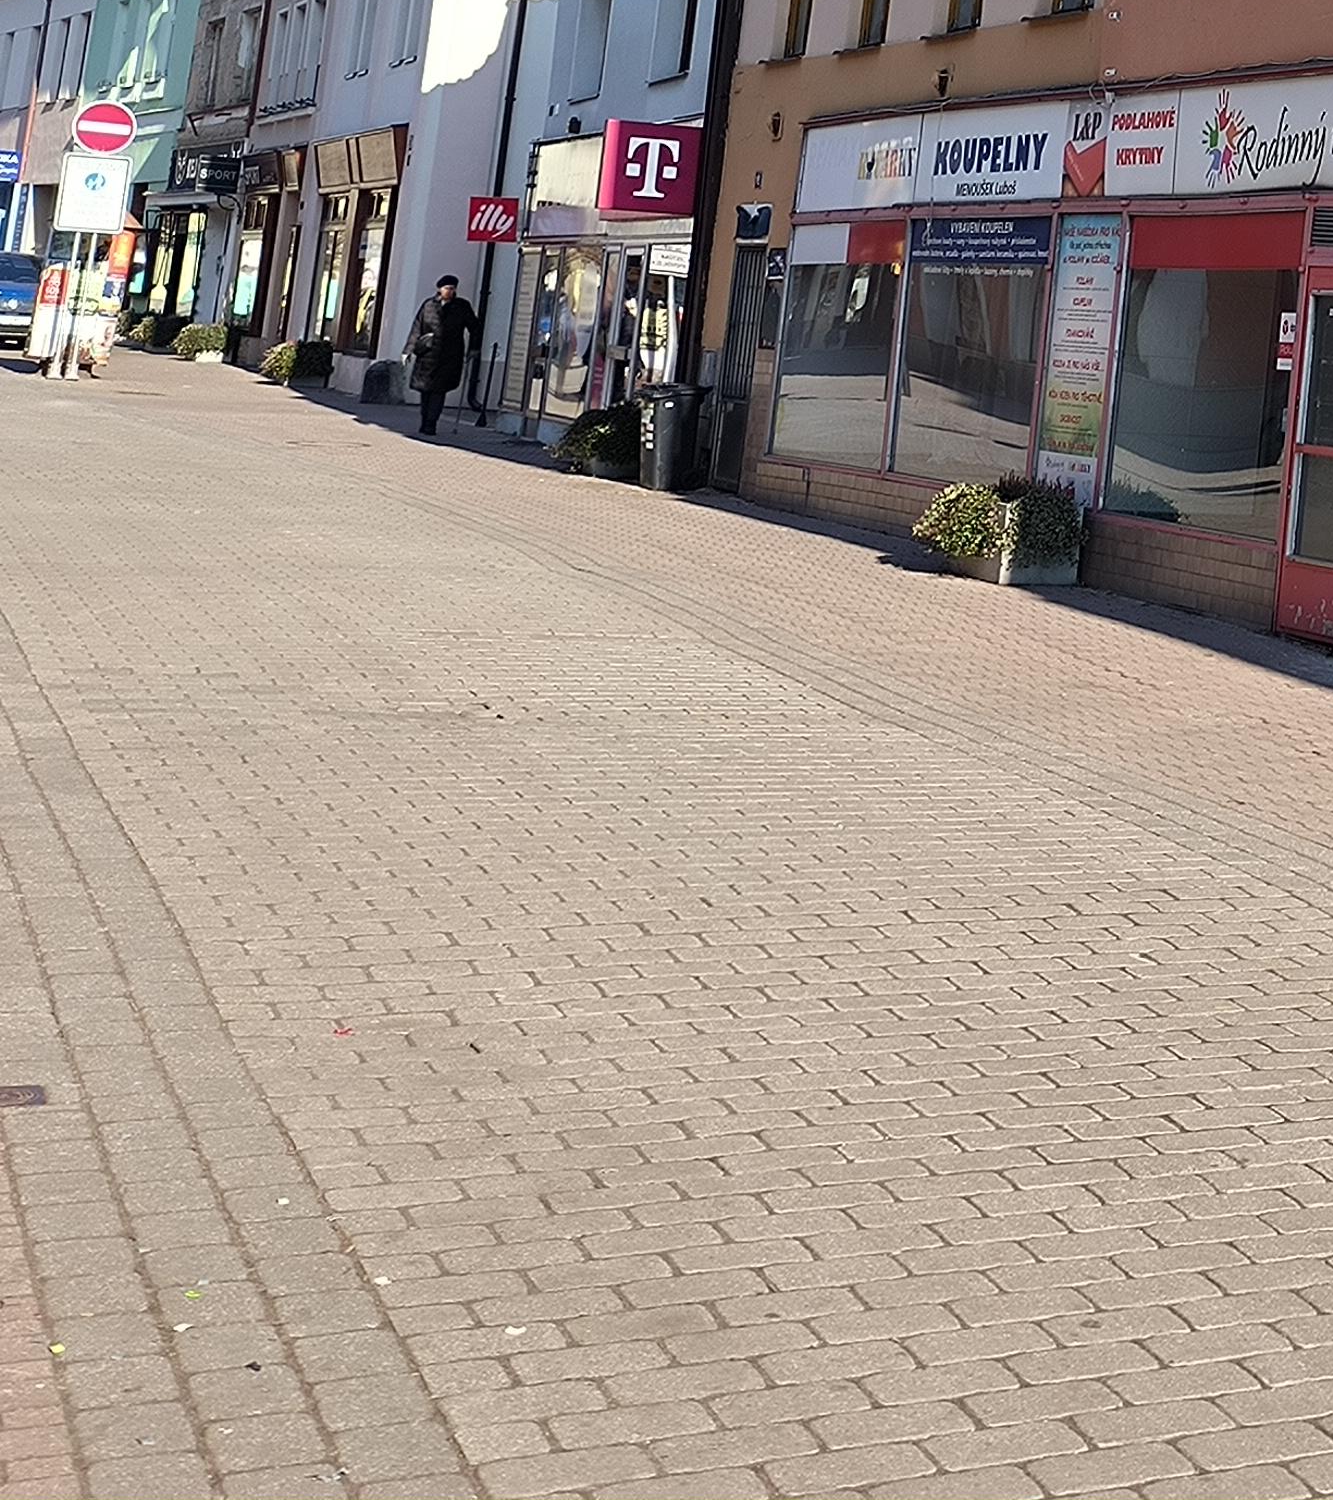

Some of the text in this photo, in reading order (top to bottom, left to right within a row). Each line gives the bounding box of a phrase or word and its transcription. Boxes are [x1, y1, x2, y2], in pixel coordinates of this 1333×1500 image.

[1072, 111, 1103, 142] L&P
[1111, 106, 1176, 131] PODLAHOVÉ
[933, 132, 1049, 176] KOUPELNY
[1116, 146, 1164, 166] KRYTINY
[1236, 105, 1327, 187] Rodinný
[200, 168, 237, 181] SPORT
[471, 203, 515, 238] illy
